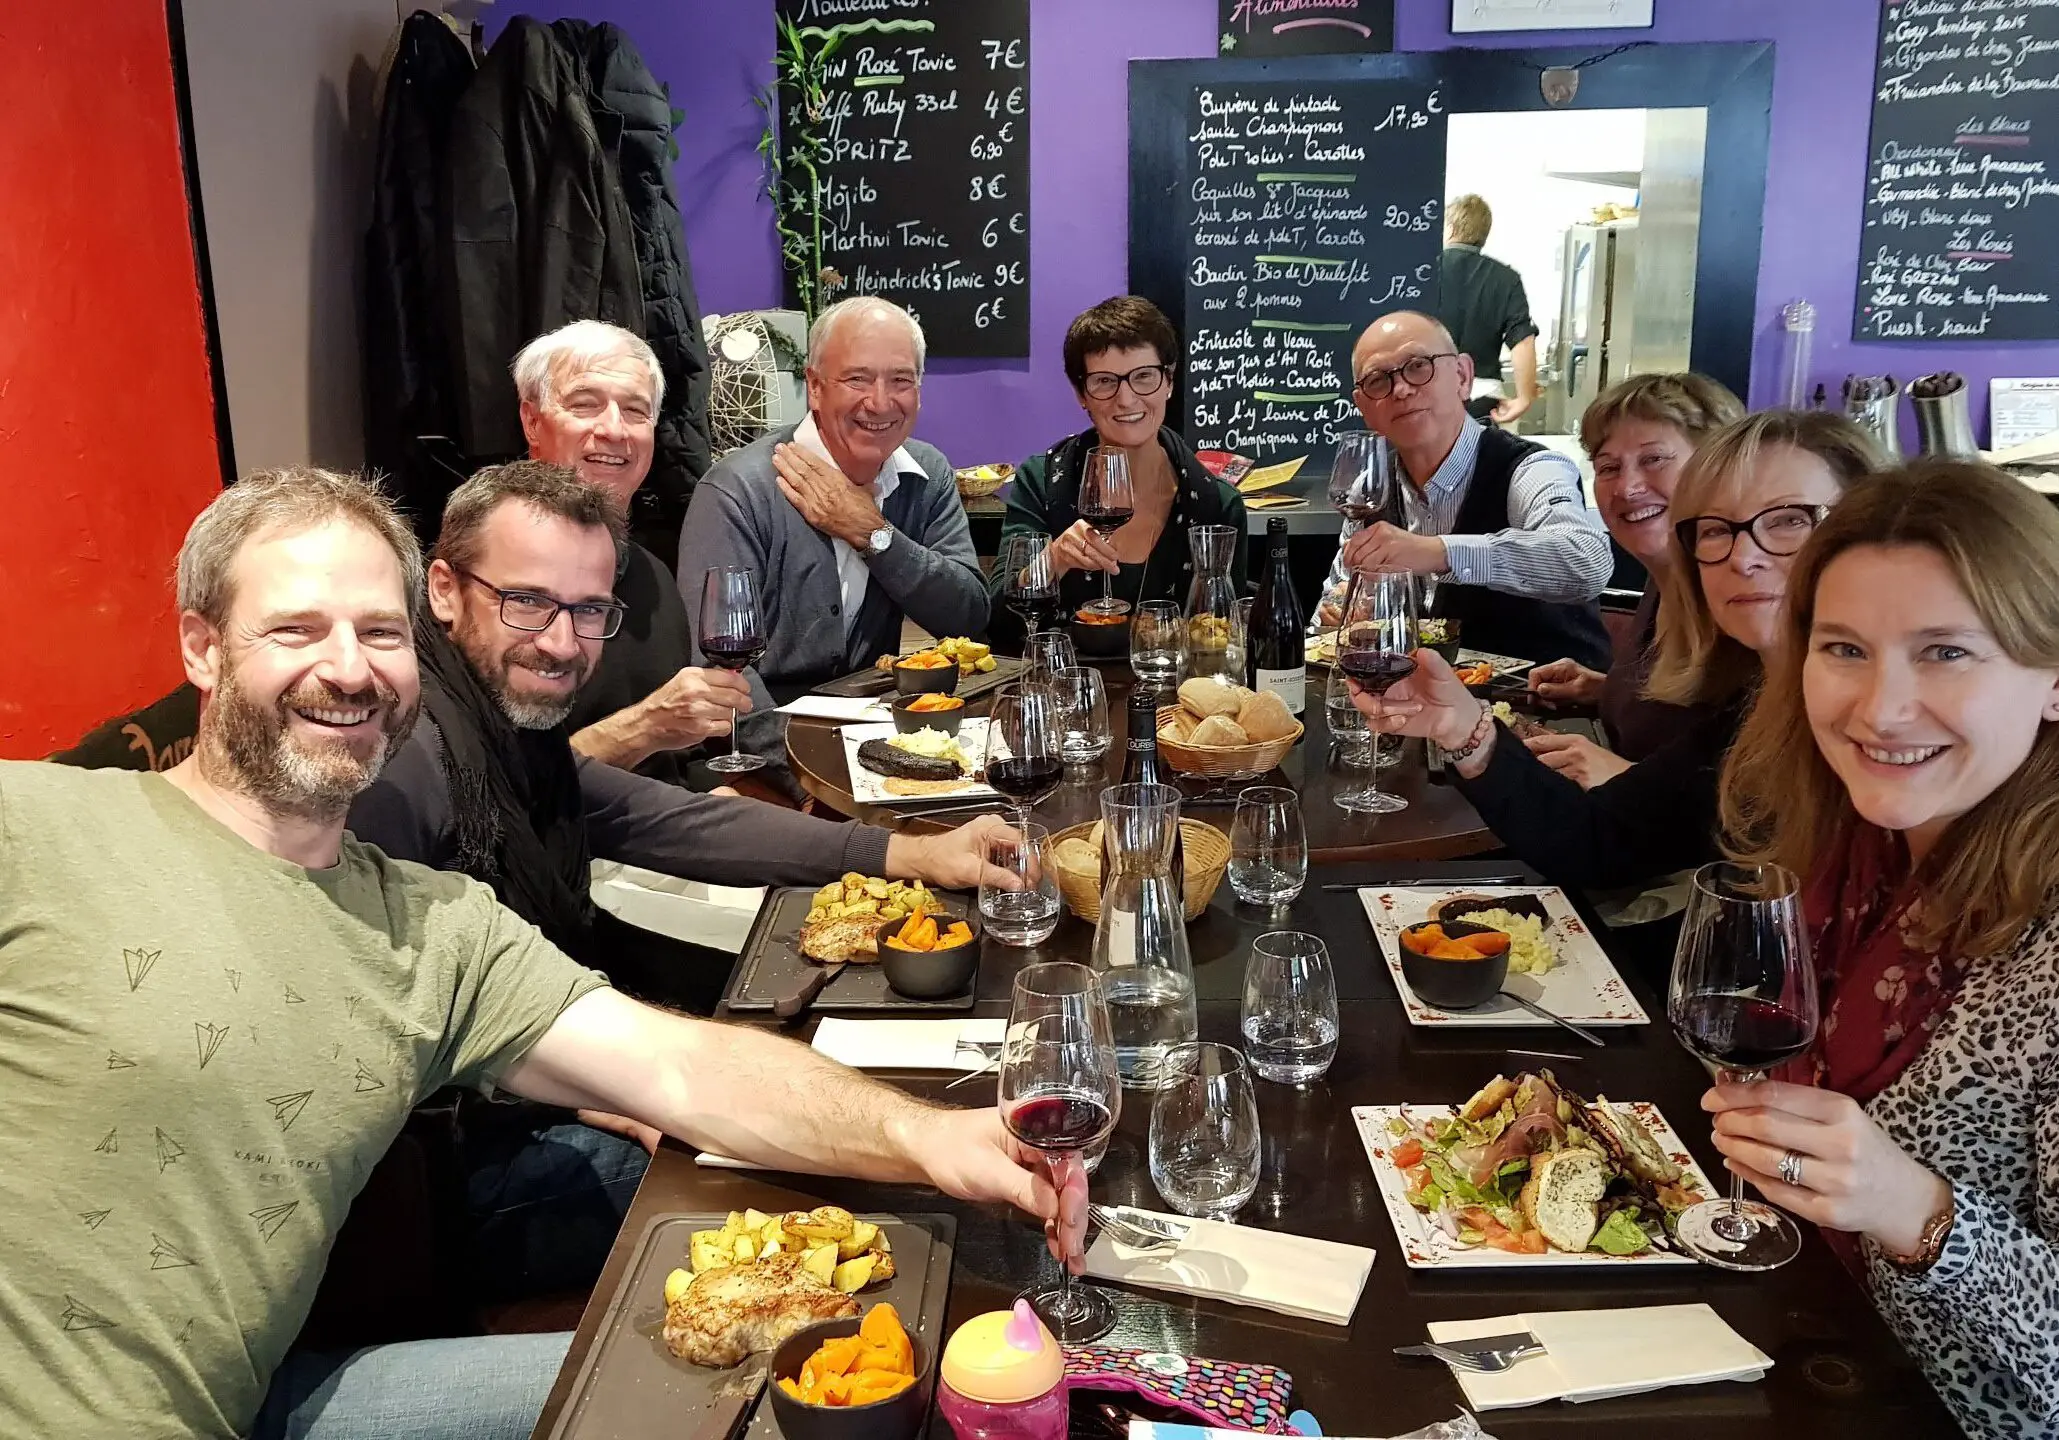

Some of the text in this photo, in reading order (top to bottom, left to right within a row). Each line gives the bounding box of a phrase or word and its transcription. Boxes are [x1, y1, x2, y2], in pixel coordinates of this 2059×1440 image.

[856, 46, 902, 76] Rosé
[981, 39, 1025, 71] 7€
[863, 89, 906, 137] Ruby
[983, 86, 1025, 119] 4€
[1264, 97, 1279, 114] de
[822, 220, 890, 251] Martini
[1245, 229, 1259, 245] de
[994, 260, 1025, 287] 9€
[1204, 296, 1227, 310] aux
[1249, 292, 1302, 317] pommes
[1263, 331, 1276, 348] de
[1283, 332, 1316, 350] Veau
[1314, 404, 1330, 420] de
[1197, 436, 1222, 450] aux
[1305, 428, 1319, 444] et
